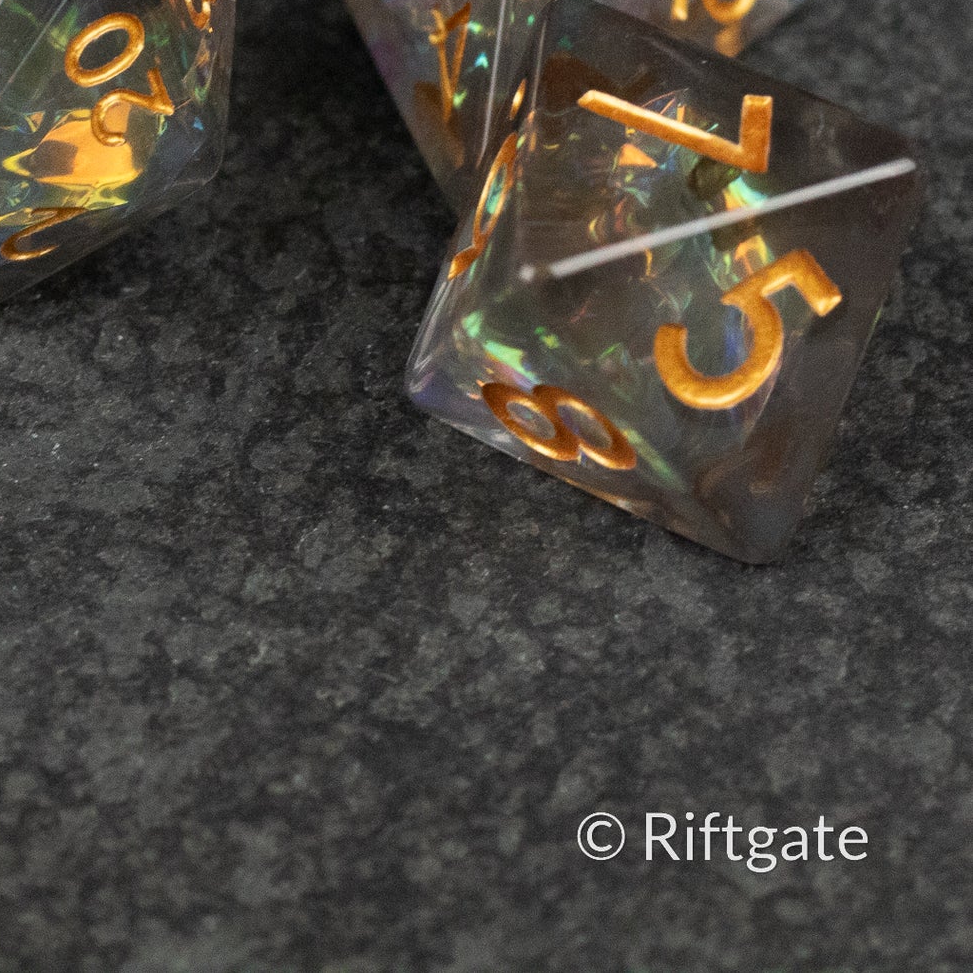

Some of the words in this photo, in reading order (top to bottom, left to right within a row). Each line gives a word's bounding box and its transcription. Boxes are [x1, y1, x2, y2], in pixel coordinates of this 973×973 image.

[64, 11, 176, 147] 20
[653, 249, 842, 410] 5
[481, 382, 637, 470] 8
